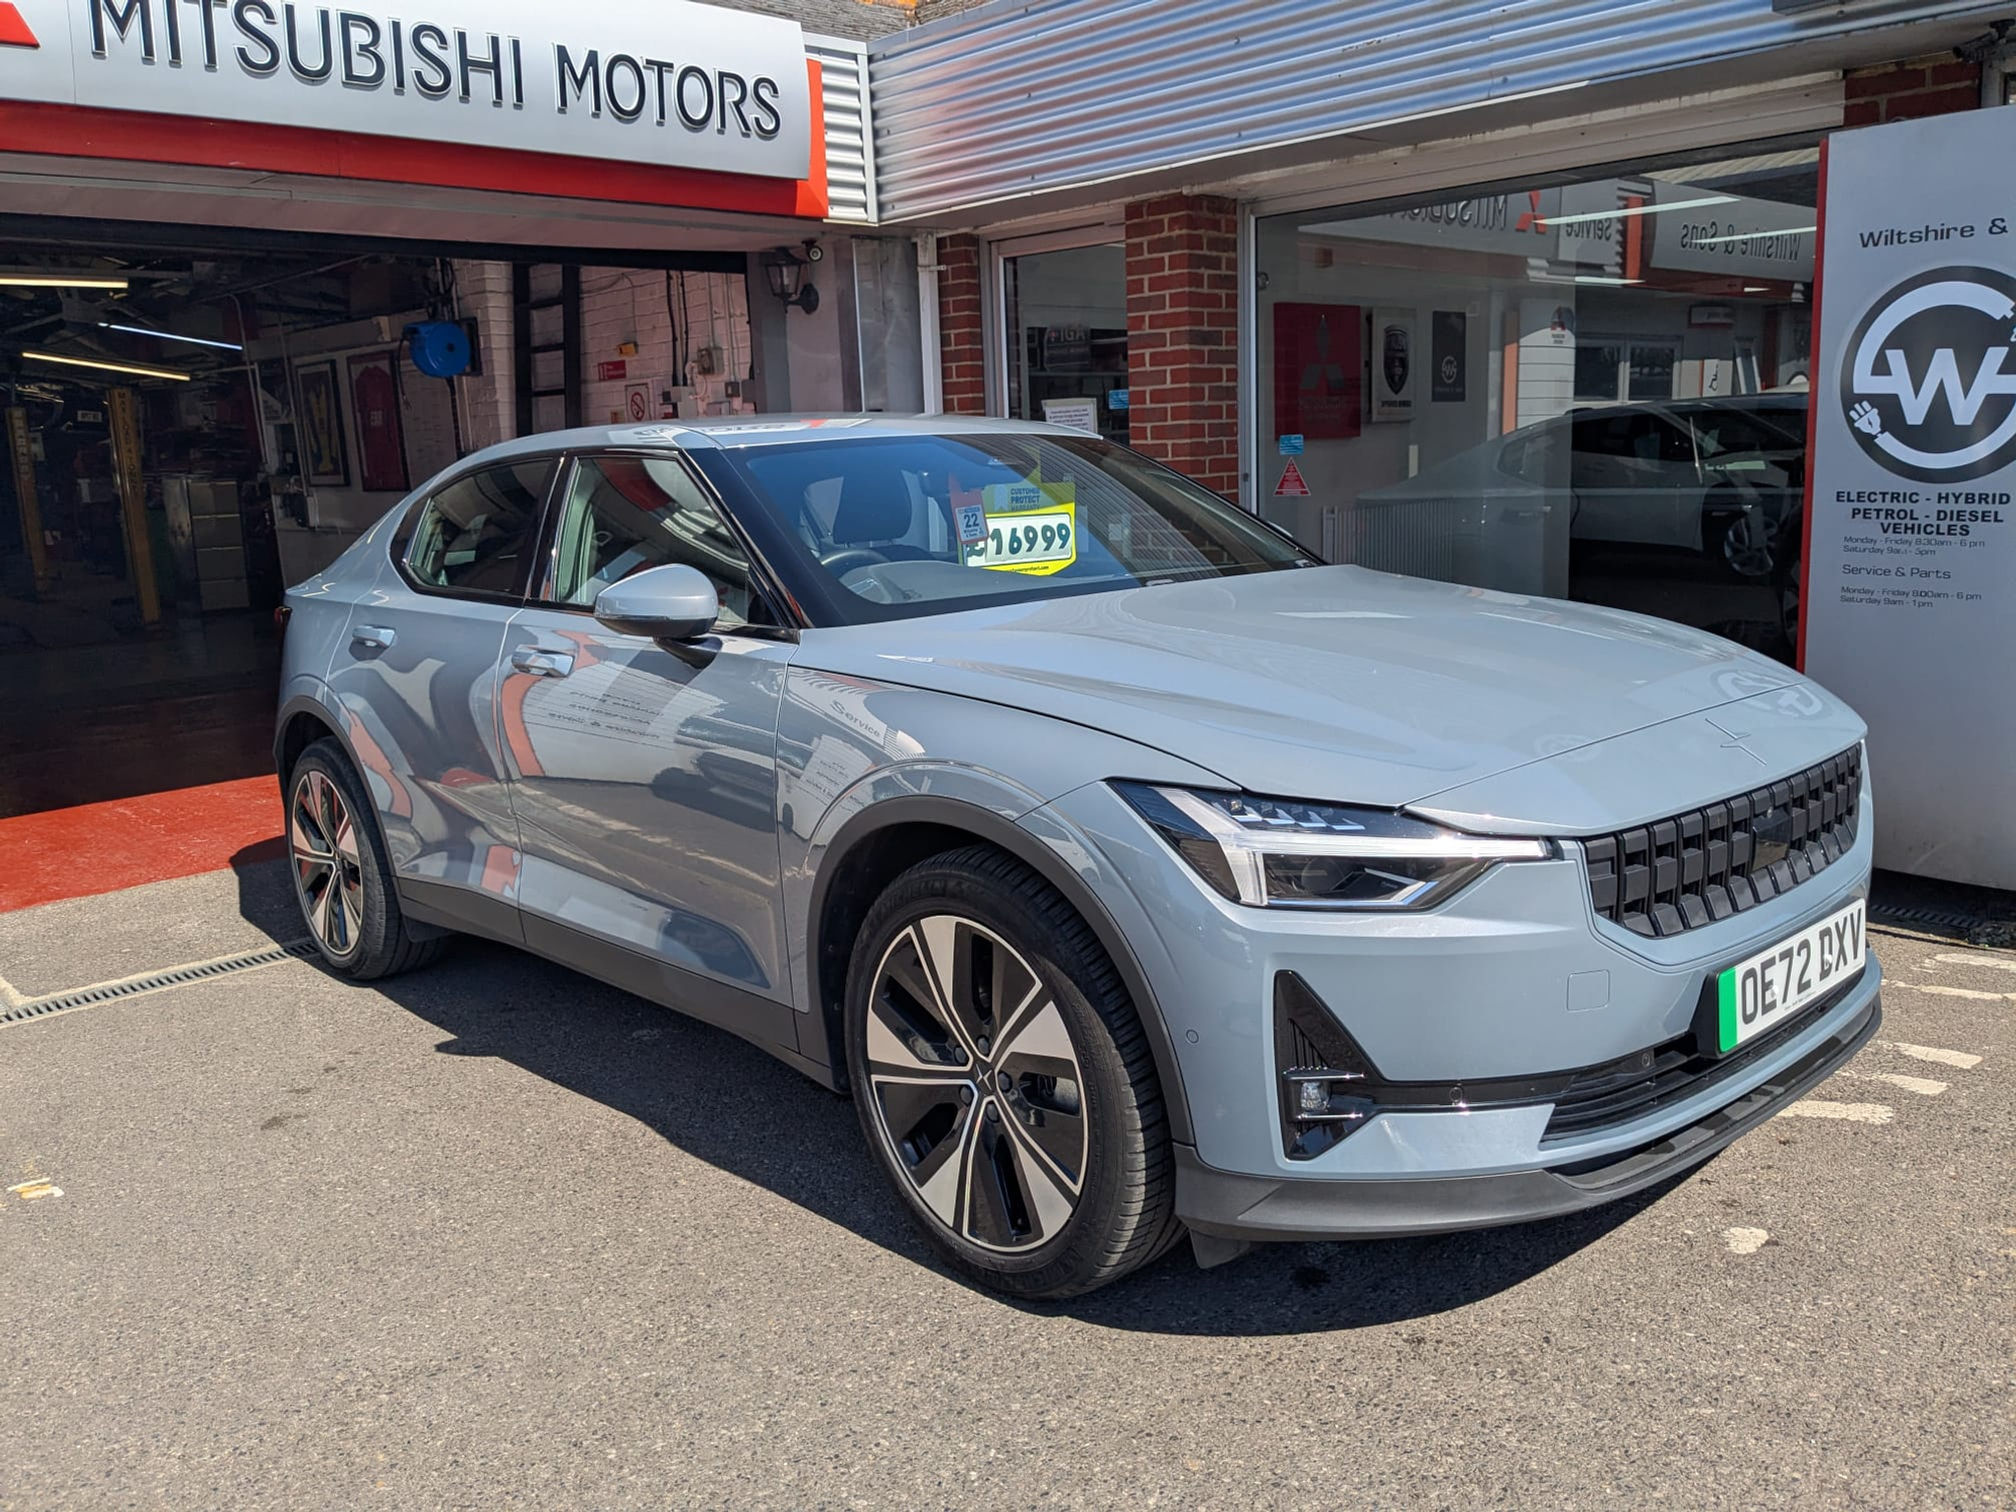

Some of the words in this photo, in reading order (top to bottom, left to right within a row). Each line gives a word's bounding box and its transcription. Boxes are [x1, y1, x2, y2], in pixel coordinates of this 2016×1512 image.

[91, 0, 526, 107] MITSUBISHI
[552, 41, 782, 140] MOTORS
[1858, 222, 1976, 248] Wiltshire
[1987, 217, 2009, 236] &
[1010, 495, 1041, 505] PROTECT
[1835, 490, 1920, 504] ELECTRIC
[1937, 492, 2012, 505] HYBRID
[963, 513, 980, 529] 22
[1850, 507, 1920, 521] PETROL
[1935, 509, 2005, 523] DIESEL
[1880, 522, 1971, 537] VEHICLES
[1843, 536, 1878, 546] Monday
[1884, 536, 1913, 546] Friday
[1842, 545, 1884, 555] Saturday
[1841, 564, 1892, 577] Service
[1894, 566, 1906, 577] &
[1910, 567, 1952, 580] Parts
[1840, 586, 1875, 597] Monday
[1881, 587, 1910, 598] Friday
[1840, 595, 1881, 606] Saturday
[1883, 596, 1905, 606] 9am
[1741, 938, 1812, 1026] OE72
[1818, 907, 1862, 983] DXV
